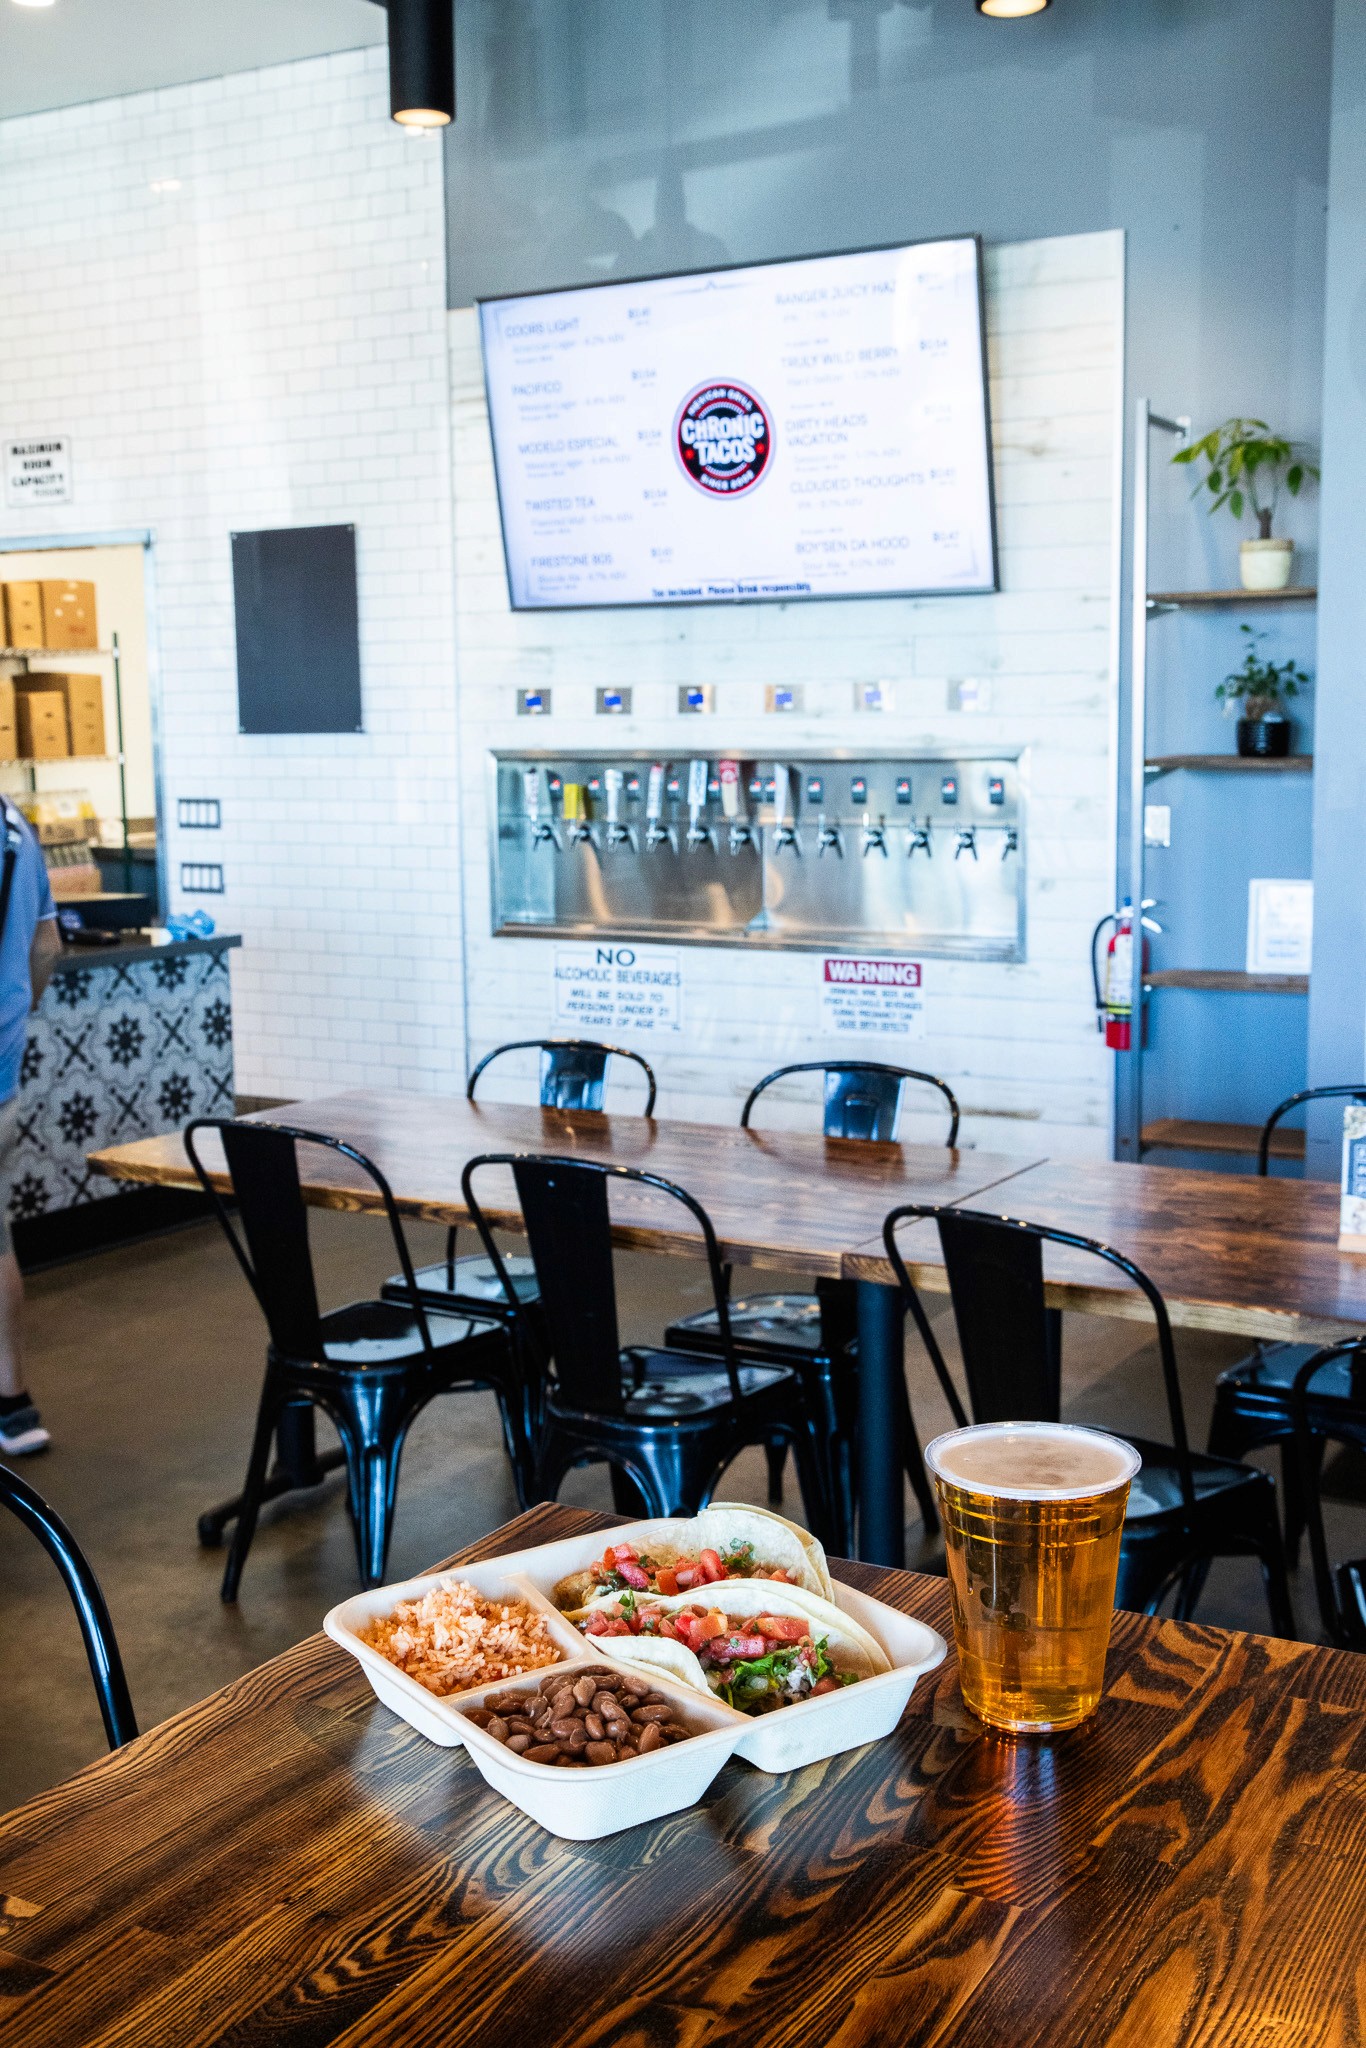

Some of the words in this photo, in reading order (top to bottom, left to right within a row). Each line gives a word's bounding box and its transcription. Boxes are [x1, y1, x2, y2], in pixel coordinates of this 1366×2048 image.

[504, 322, 544, 338] COORS
[548, 317, 580, 334] LIGHT
[512, 381, 562, 396] PACIFICO
[681, 411, 765, 444] CHRONIC
[518, 441, 565, 455] MODELO
[567, 437, 620, 452] ESPECIAL
[786, 432, 848, 448] VACATION
[11, 443, 61, 455] MAXIMUM
[693, 434, 757, 466] TACOS
[23, 460, 51, 469] ROOM
[12, 474, 62, 486] CAPACITY
[790, 479, 851, 494] CLOUDED
[854, 471, 925, 488] THOUGHTS
[525, 498, 572, 512] TWISTED
[575, 496, 597, 509] TEA
[871, 536, 911, 550] HOOD
[530, 555, 589, 568] FIRESTONE
[597, 949, 635, 966] NO
[554, 968, 610, 982] ALCOHOLIC
[616, 970, 681, 987] BEVERAGES
[827, 961, 917, 985] WARNING
[571, 989, 591, 998] WILL
[617, 992, 644, 1001] SOLD
[650, 993, 662, 1002] TO
[566, 1002, 613, 1012] PERSONS
[619, 1004, 654, 1014] UNDER
[580, 1016, 611, 1025] YEARS
[616, 1017, 629, 1026] OF
[635, 1019, 654, 1028] AGE
